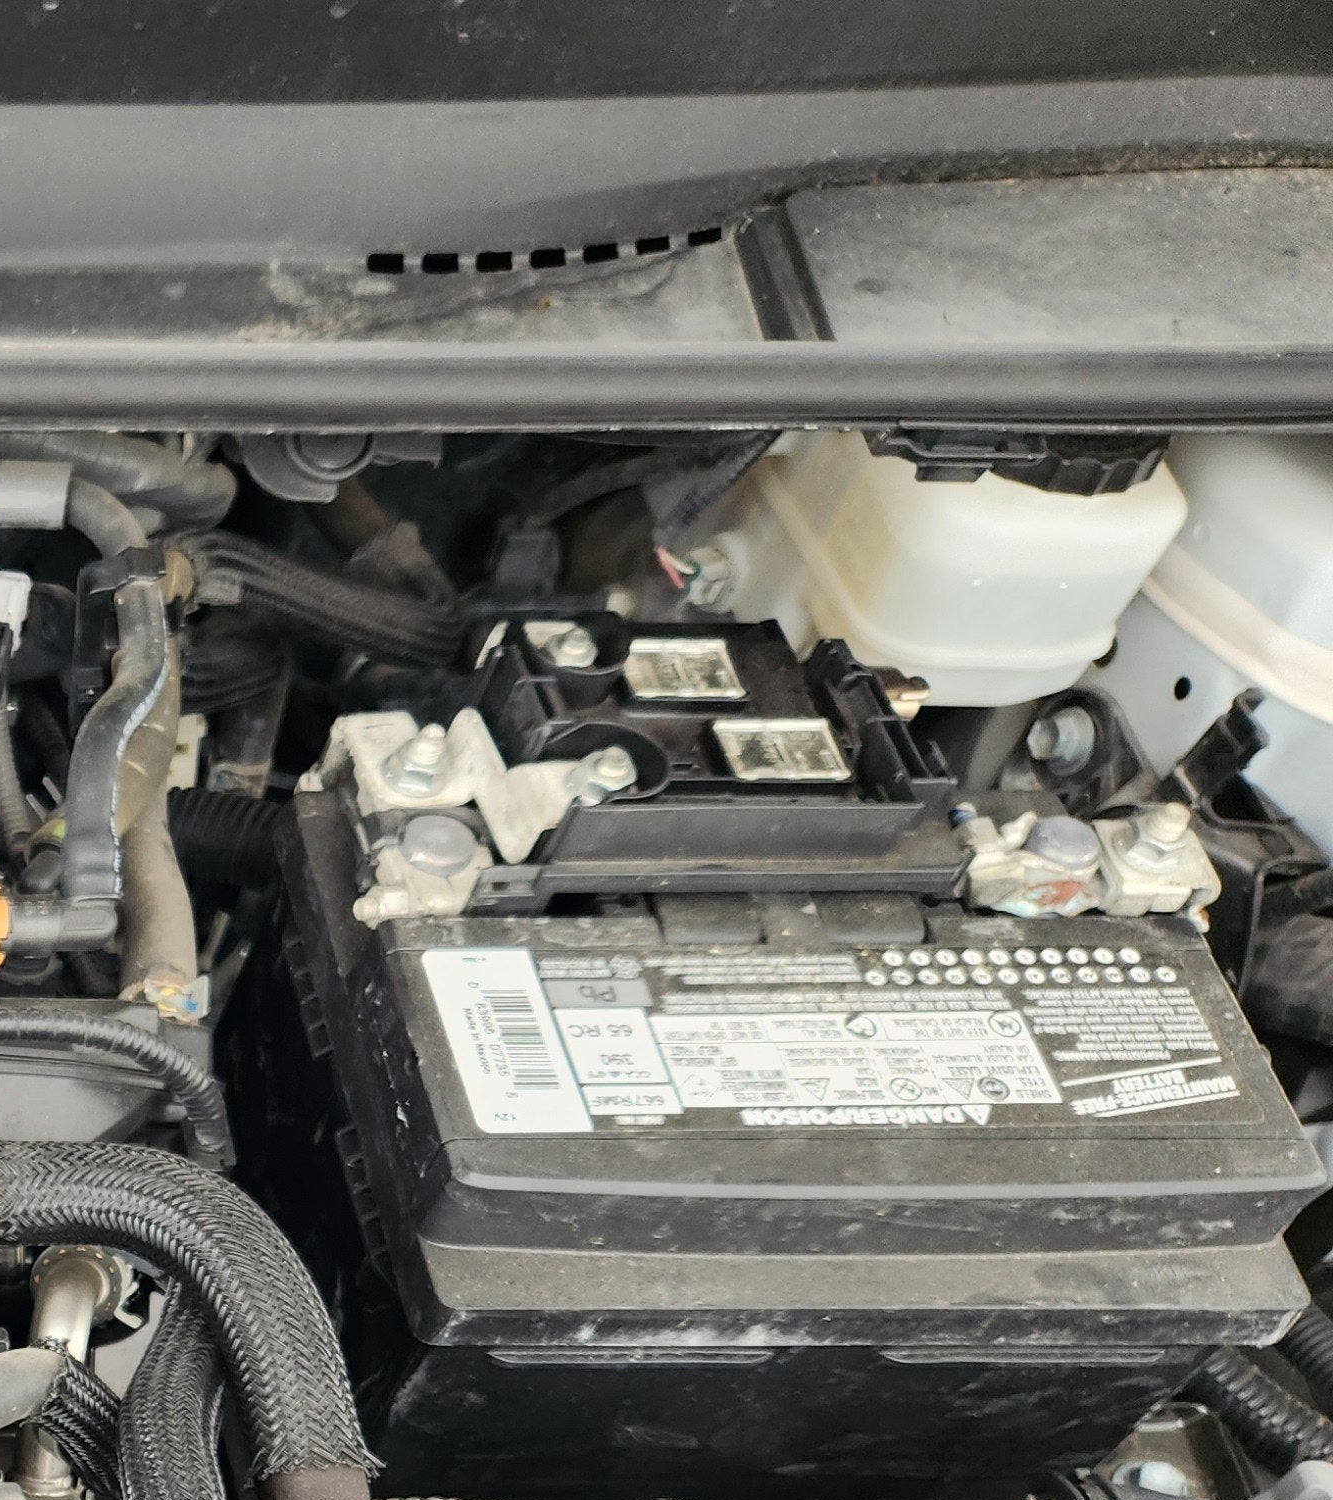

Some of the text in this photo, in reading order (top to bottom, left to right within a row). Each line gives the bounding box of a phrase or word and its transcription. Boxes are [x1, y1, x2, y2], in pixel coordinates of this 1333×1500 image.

[578, 985, 617, 1003] Pb
[567, 1025, 602, 1039] RC
[1111, 1069, 1186, 1094] BATTERY
[1069, 1076, 1237, 1116] MAINTENANCE-FREE
[493, 1112, 517, 1122] 12V
